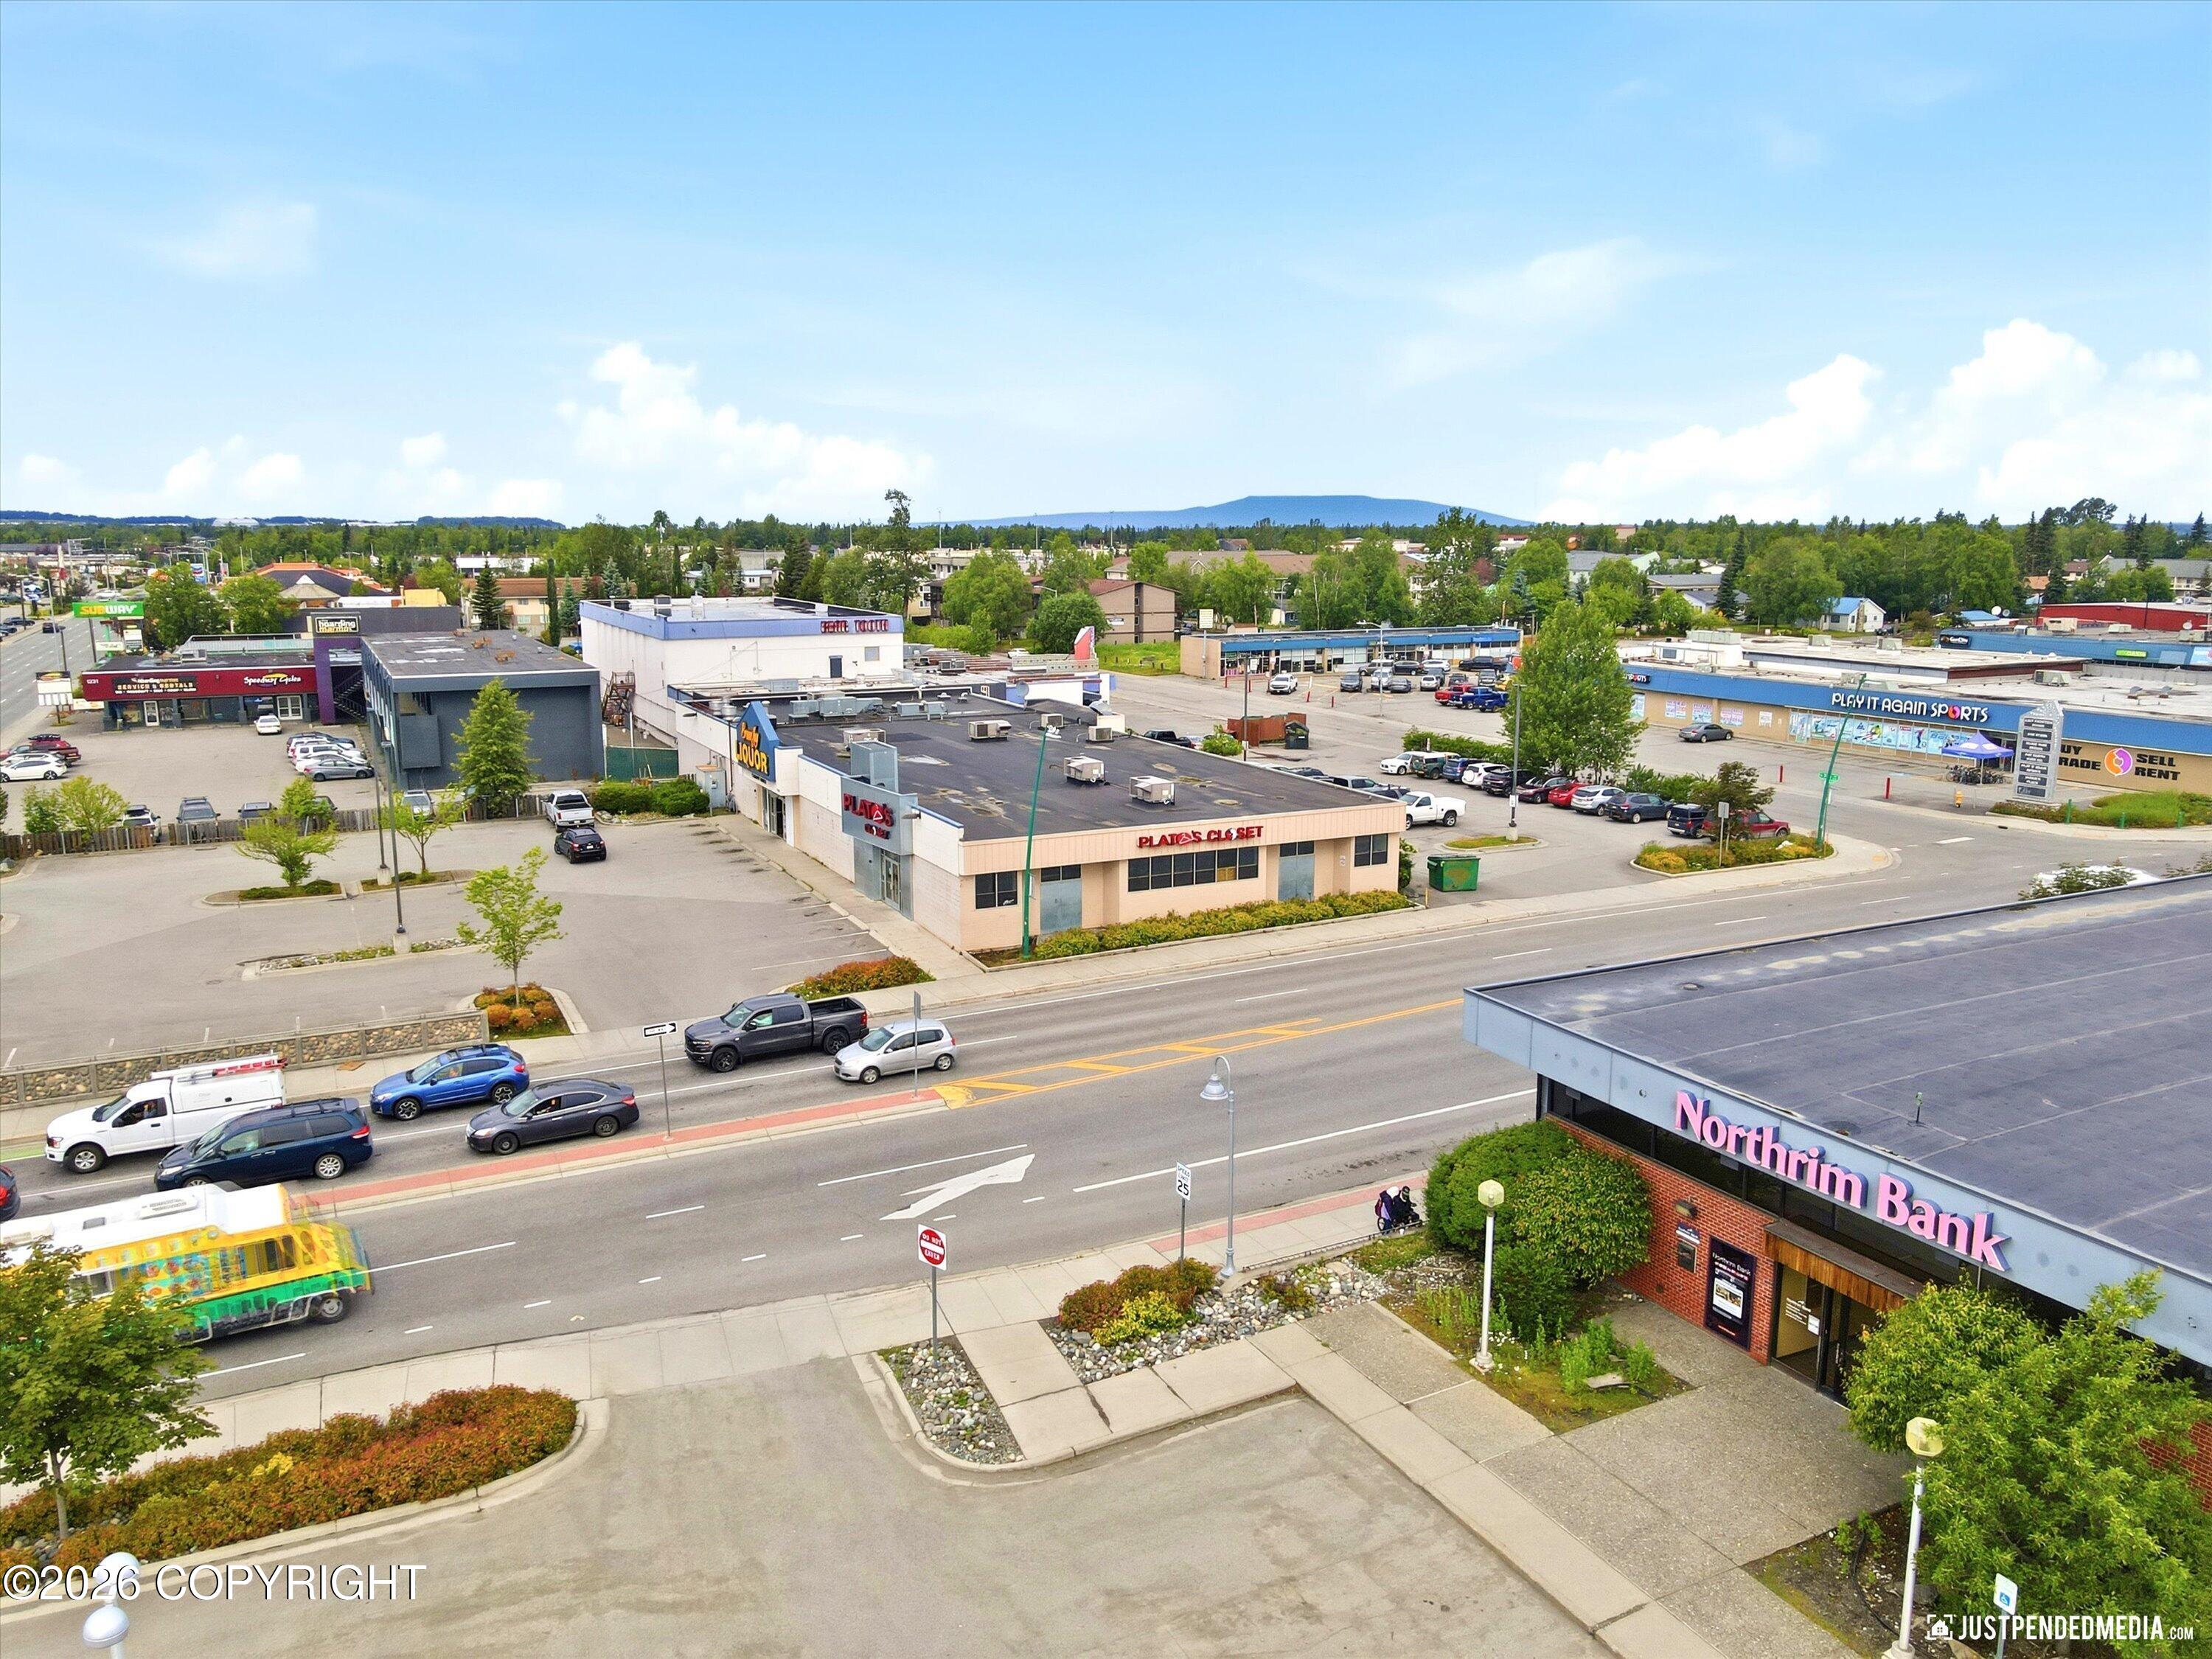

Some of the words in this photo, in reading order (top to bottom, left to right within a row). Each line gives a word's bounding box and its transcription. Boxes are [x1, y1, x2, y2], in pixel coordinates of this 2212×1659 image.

[80, 605, 137, 615] SUBWAY
[1832, 692, 1864, 709] PLAY
[1867, 696, 1879, 710] IT
[1881, 698, 1927, 716] AGAIN
[1930, 702, 1988, 723] SPORTS
[2060, 744, 2082, 756] UY
[736, 740, 768, 775] LIQUOR
[2059, 757, 2101, 771] RADE
[2137, 754, 2176, 767] SELL
[2135, 767, 2180, 781] RENT
[1138, 830, 1203, 848] PLATO'S
[1206, 826, 1264, 842] CLOSET
[1178, 1179, 1189, 1196] 25
[1674, 1090, 1868, 1210] Northrim
[1877, 1171, 2011, 1273] Bank
[922, 1233, 930, 1241] DO
[931, 1237, 942, 1246] NOT
